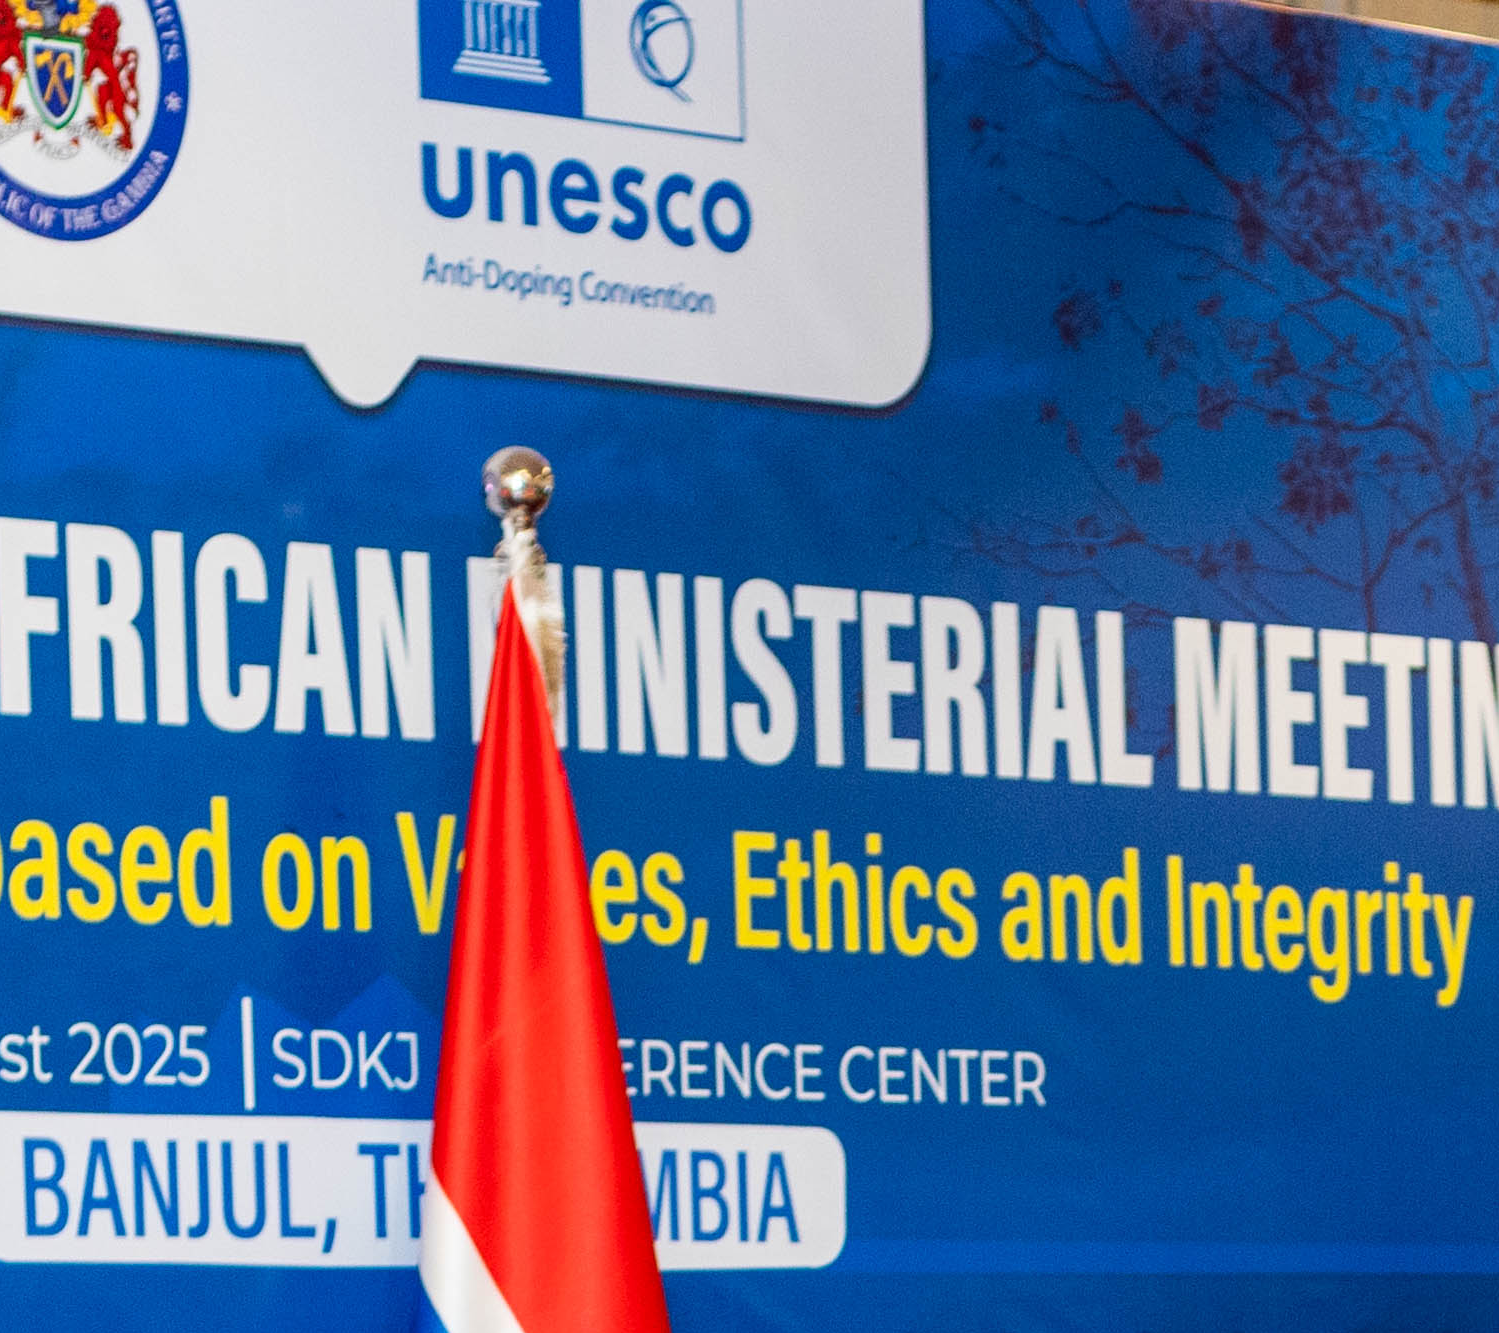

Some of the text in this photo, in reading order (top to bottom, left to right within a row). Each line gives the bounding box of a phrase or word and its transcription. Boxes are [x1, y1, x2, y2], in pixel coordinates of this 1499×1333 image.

[421, 142, 751, 253] unesco
[423, 252, 715, 313] Anti-Doping Convention
[262, 832, 371, 932] on
[395, 811, 708, 963] Ves,
[732, 829, 979, 959] Ethics
[1000, 847, 1142, 965] and
[1167, 854, 1474, 1007] Integrity
[68, 1022, 210, 1086] 2025
[272, 1028, 419, 1090] SDKJ
[840, 1046, 1047, 1105] CENTER
[22, 1137, 338, 1255] BANJUL,
[638, 1148, 800, 1243] MBIA
